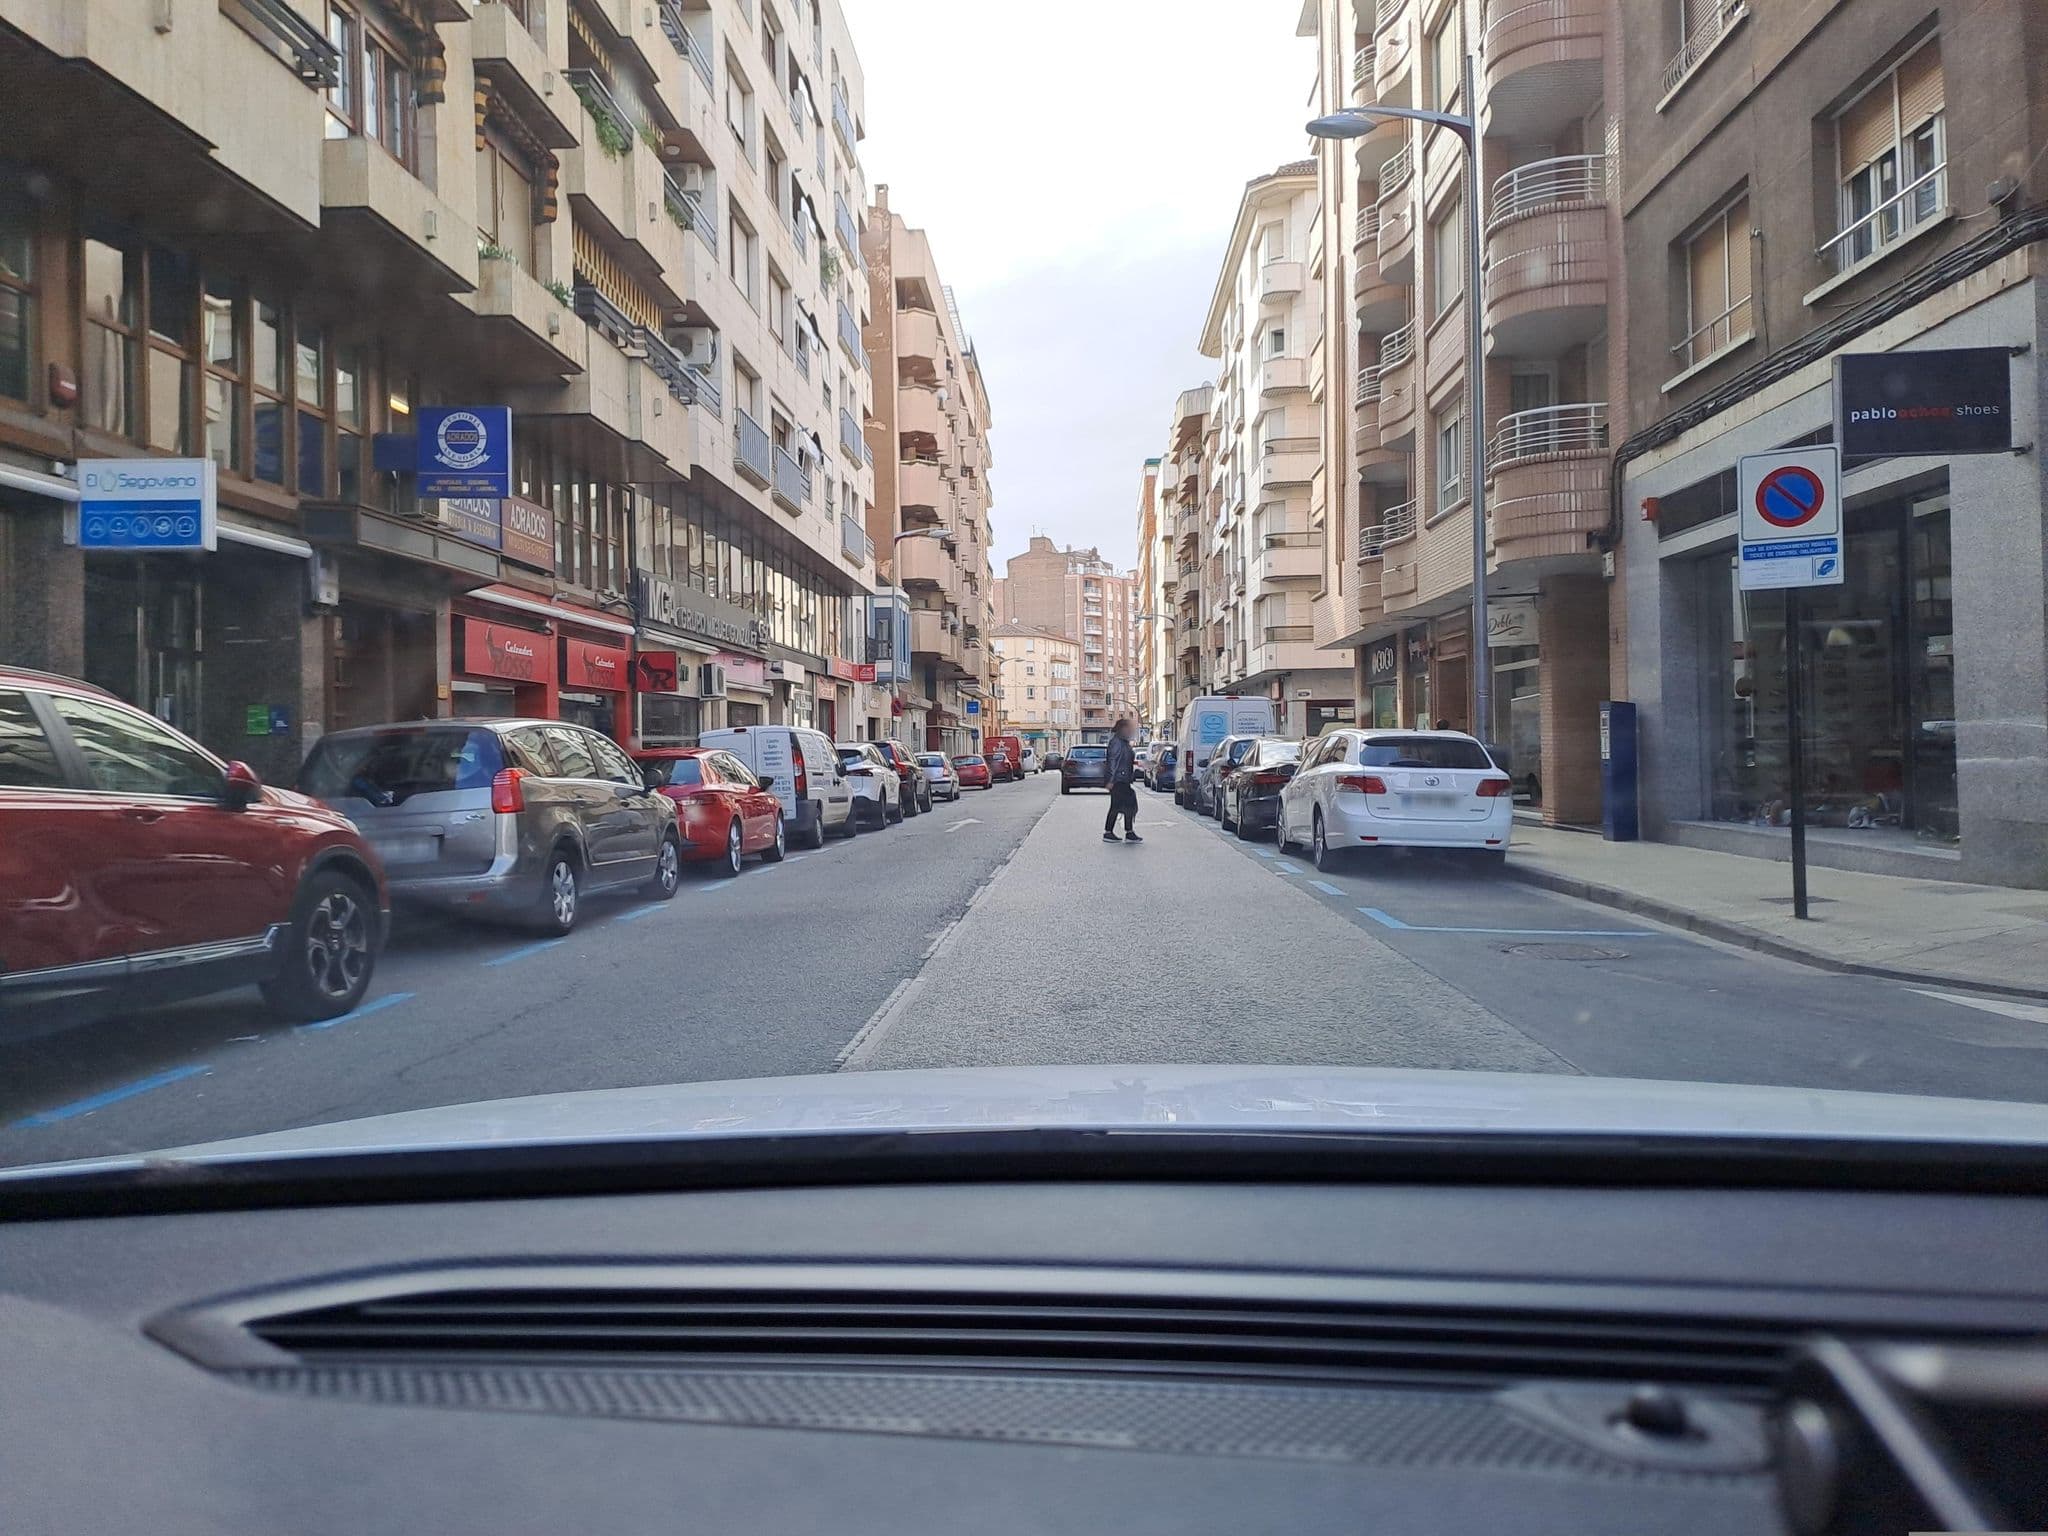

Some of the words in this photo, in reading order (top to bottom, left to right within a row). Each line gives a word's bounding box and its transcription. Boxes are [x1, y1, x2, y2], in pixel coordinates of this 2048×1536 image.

[1956, 404, 2000, 416] shoes
[446, 432, 479, 442] ADRADOS
[118, 473, 196, 489] Segoviano
[510, 503, 546, 540] ADRADOS
